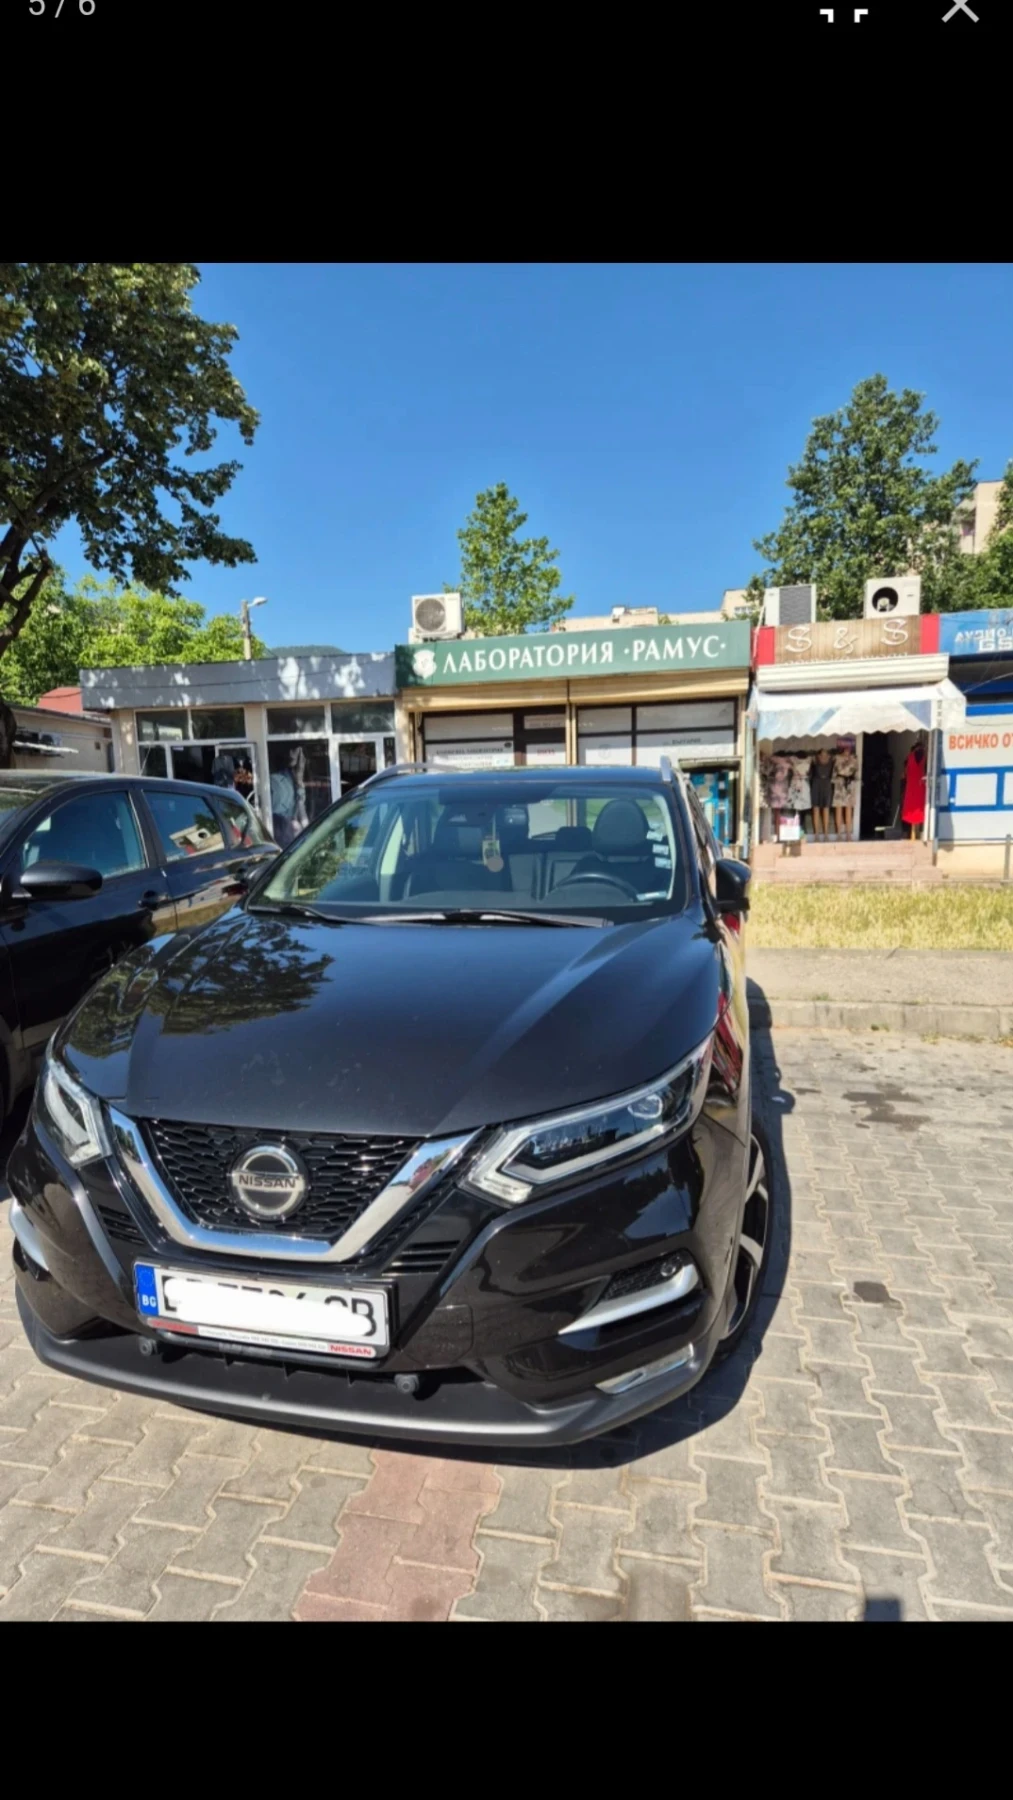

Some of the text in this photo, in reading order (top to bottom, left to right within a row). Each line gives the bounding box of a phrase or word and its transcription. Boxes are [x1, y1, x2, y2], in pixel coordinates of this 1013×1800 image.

[785, 618, 909, 654] S & S
[442, 643, 613, 674] ЛАБОРАТОРИЯ
[948, 732, 1013, 751] ВСИЧКО О
[239, 1174, 296, 1189] NISSAN
[141, 1294, 157, 1308] BG
[329, 1343, 373, 1357] NISSAN
